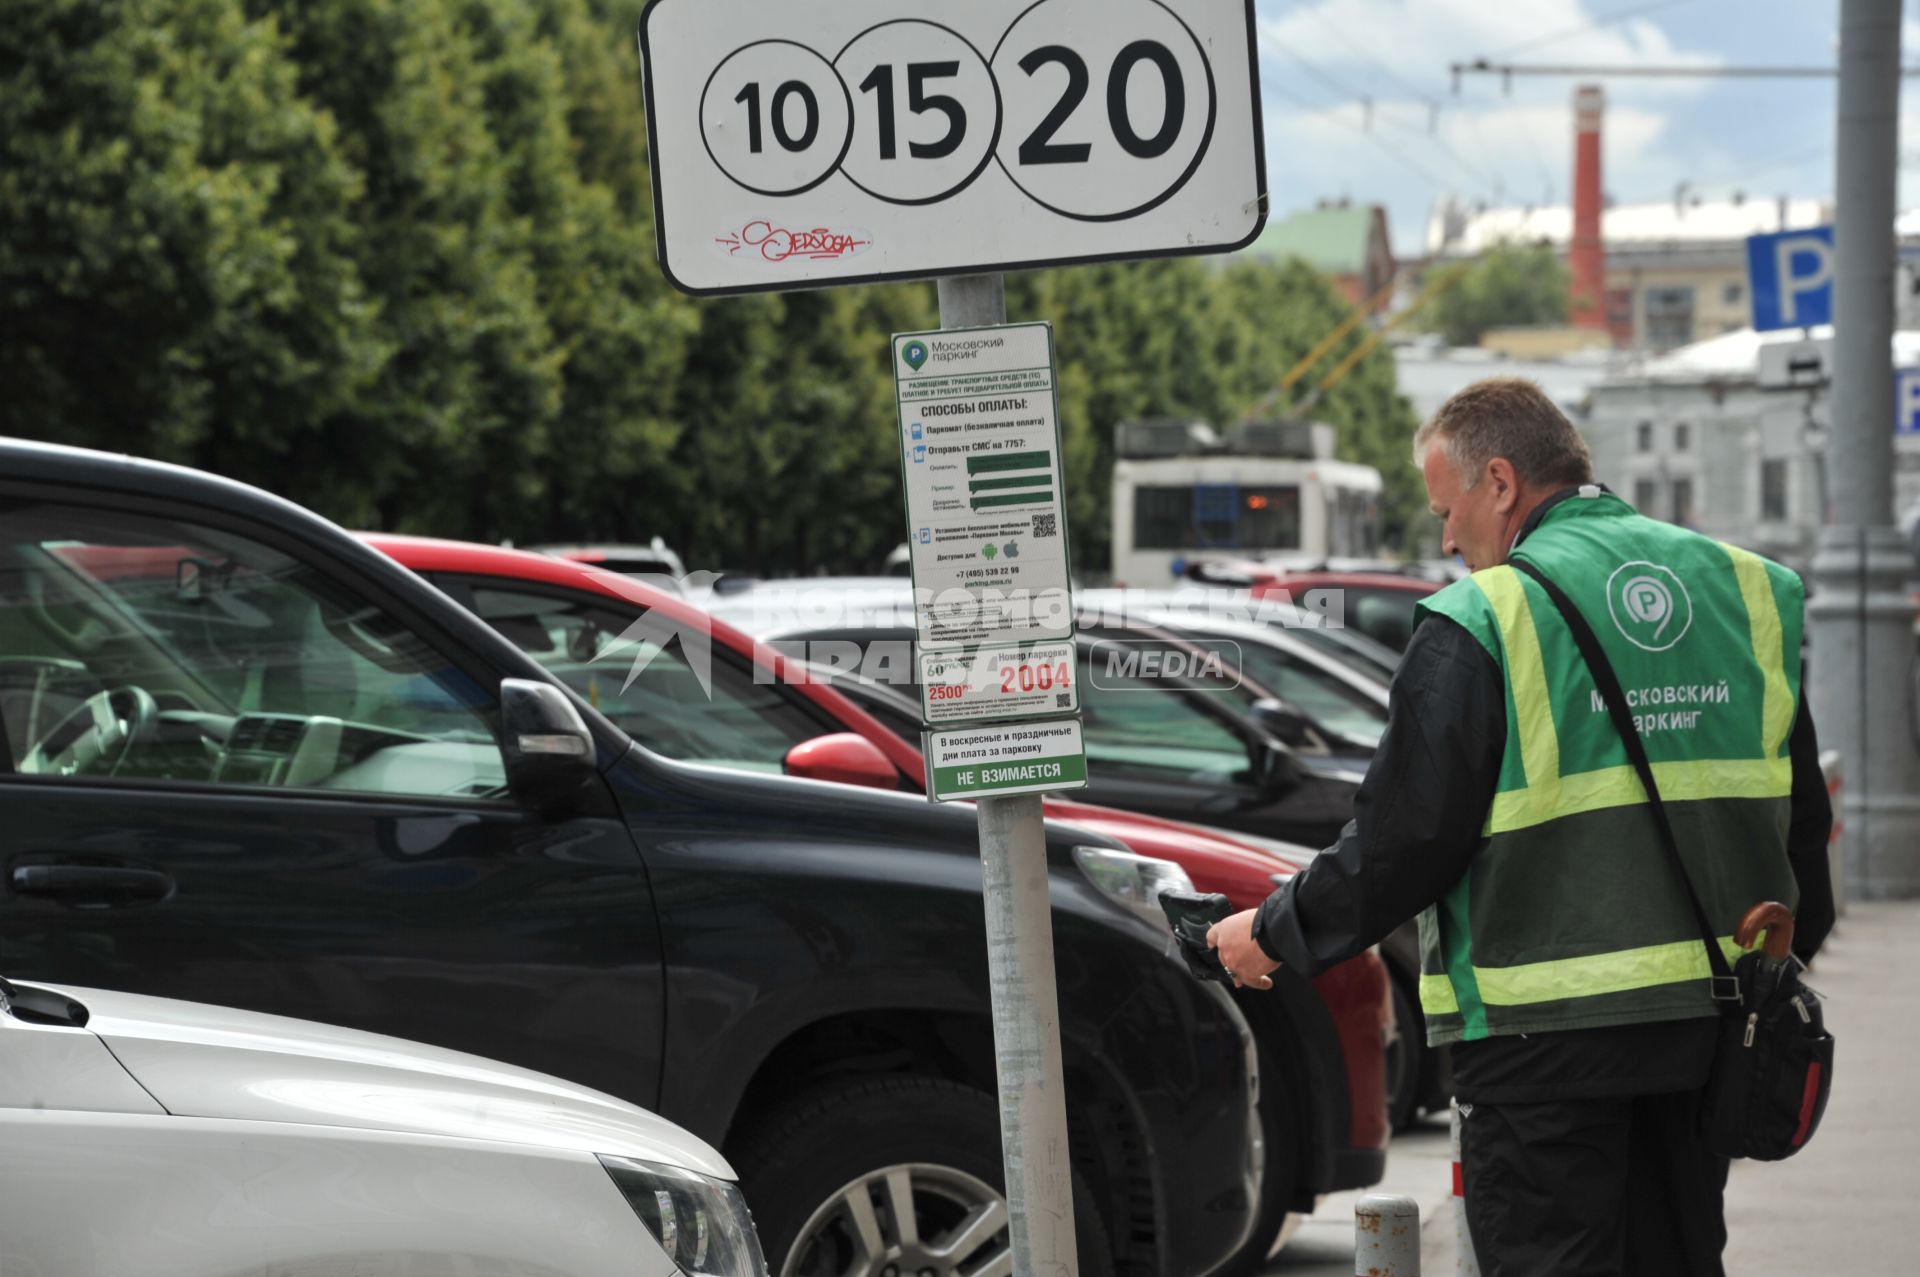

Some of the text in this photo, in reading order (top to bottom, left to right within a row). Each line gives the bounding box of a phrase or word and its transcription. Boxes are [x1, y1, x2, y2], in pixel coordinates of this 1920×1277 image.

[734, 39, 1185, 165] 10 15 20
[1775, 236, 1833, 324] P
[931, 338, 1004, 352] Московский
[932, 349, 978, 363] паркинг
[902, 390, 929, 398] ПЛАТНОЕ
[937, 386, 962, 395] ТРЕБУЕТ
[964, 381, 1022, 393] ПРЕДВАРИТЕЛЬНОЙ
[1023, 379, 1049, 389] ОПЛАТЫ
[951, 375, 999, 386] ТРАНСПОРТНЫХ
[921, 398, 1028, 417] СПОСОБЫ ОПЛАТЫ:
[926, 416, 1045, 435] Паркомат (безналичная оплата)
[928, 444, 970, 455] Отправьте
[992, 442, 1003, 450] на
[1004, 438, 1026, 449] 7757:
[956, 571, 964, 579] +7
[966, 569, 984, 578] (495)
[1000, 566, 1009, 575] 22
[1638, 590, 1657, 615] P
[999, 650, 1068, 662] Номер парковки
[927, 664, 944, 677] 60
[1000, 662, 1071, 694] 2004
[929, 685, 963, 700] 2500
[1590, 680, 1730, 713] Мсковский
[1631, 710, 1703, 738] аркинг
[941, 737, 947, 747] В
[949, 733, 1002, 747] воскресные
[1012, 727, 1072, 742] праздничные
[942, 743, 1042, 762] дни плата за парковку
[957, 763, 1061, 786] НЕ ВЗИМАЕТСЯ
